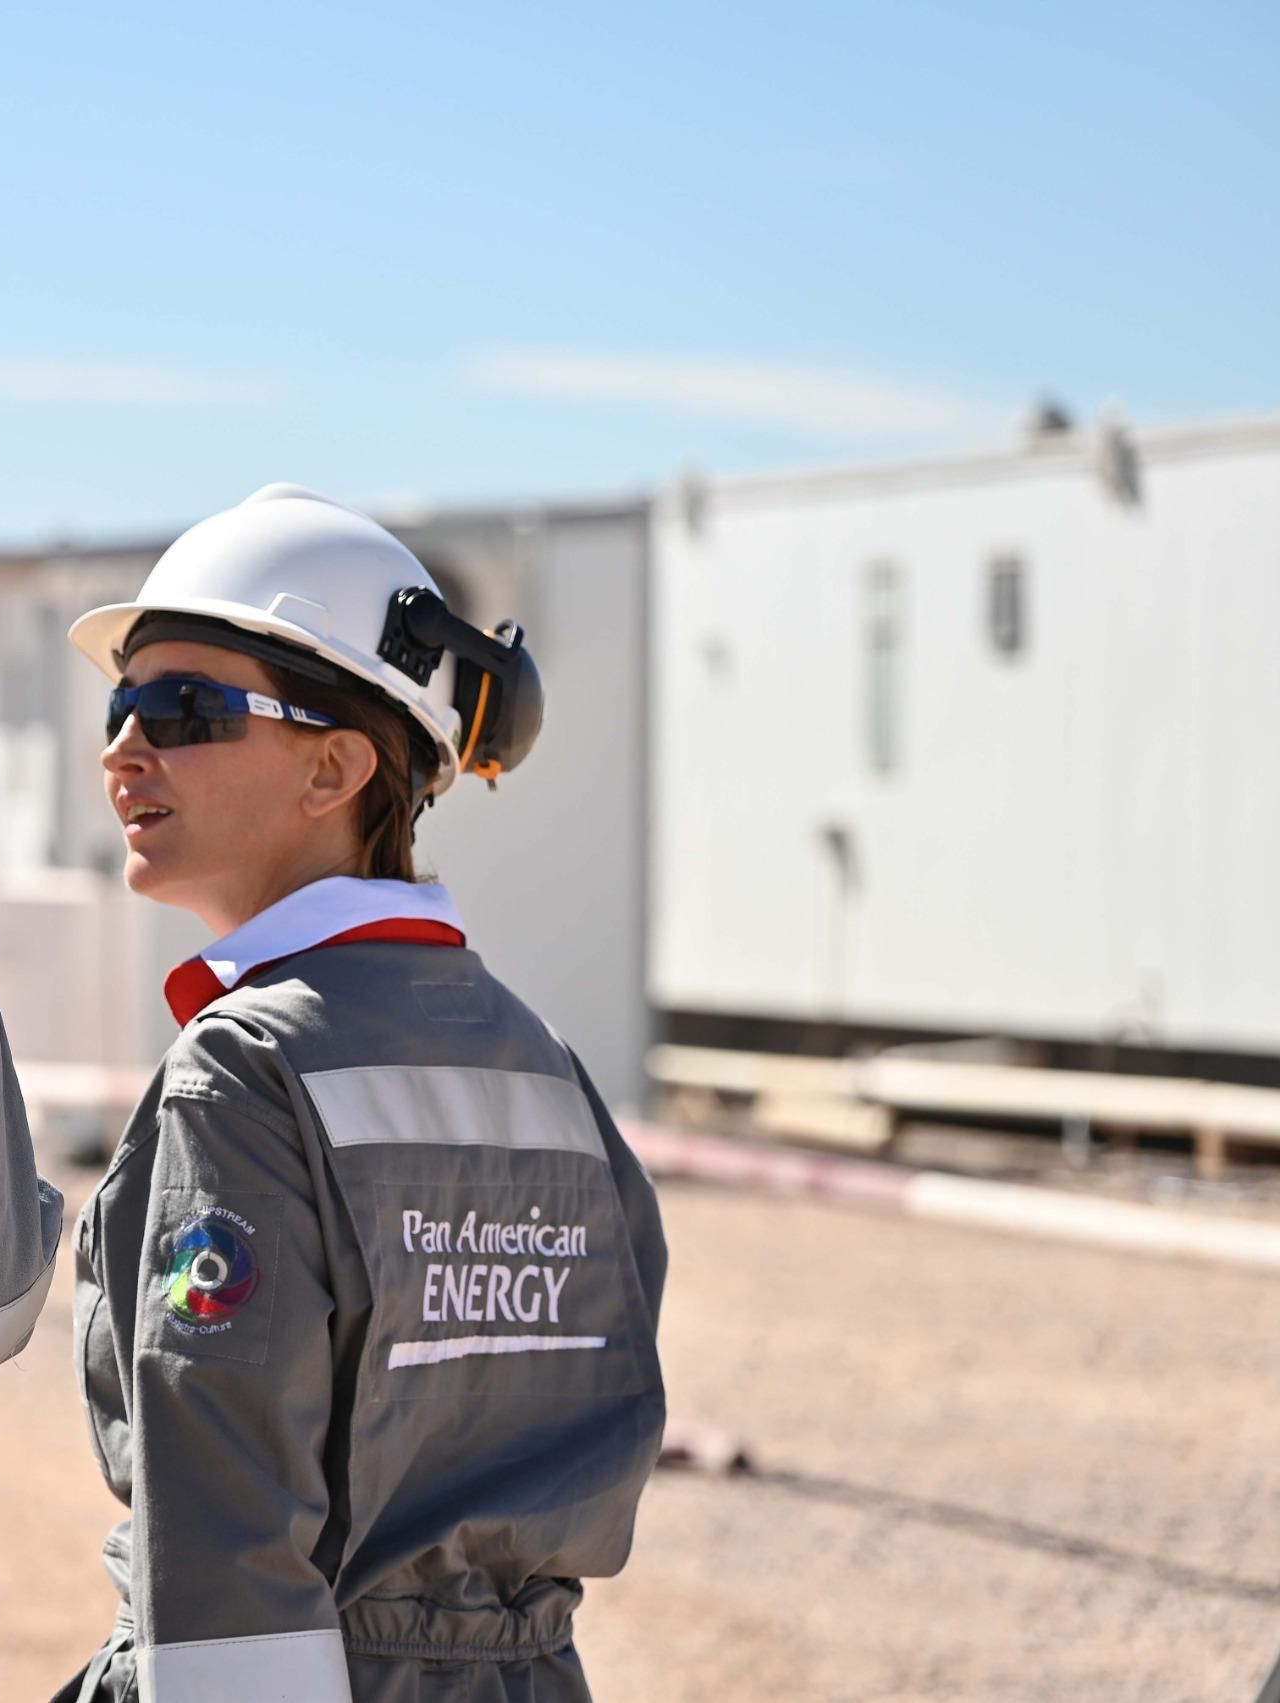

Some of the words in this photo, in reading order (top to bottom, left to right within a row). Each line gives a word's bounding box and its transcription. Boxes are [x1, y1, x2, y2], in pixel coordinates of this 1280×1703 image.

[202, 1205, 256, 1236] UPSTREAM
[402, 1210, 452, 1253] Pan
[456, 1206, 588, 1257] American
[423, 1264, 570, 1323] ENERGY
